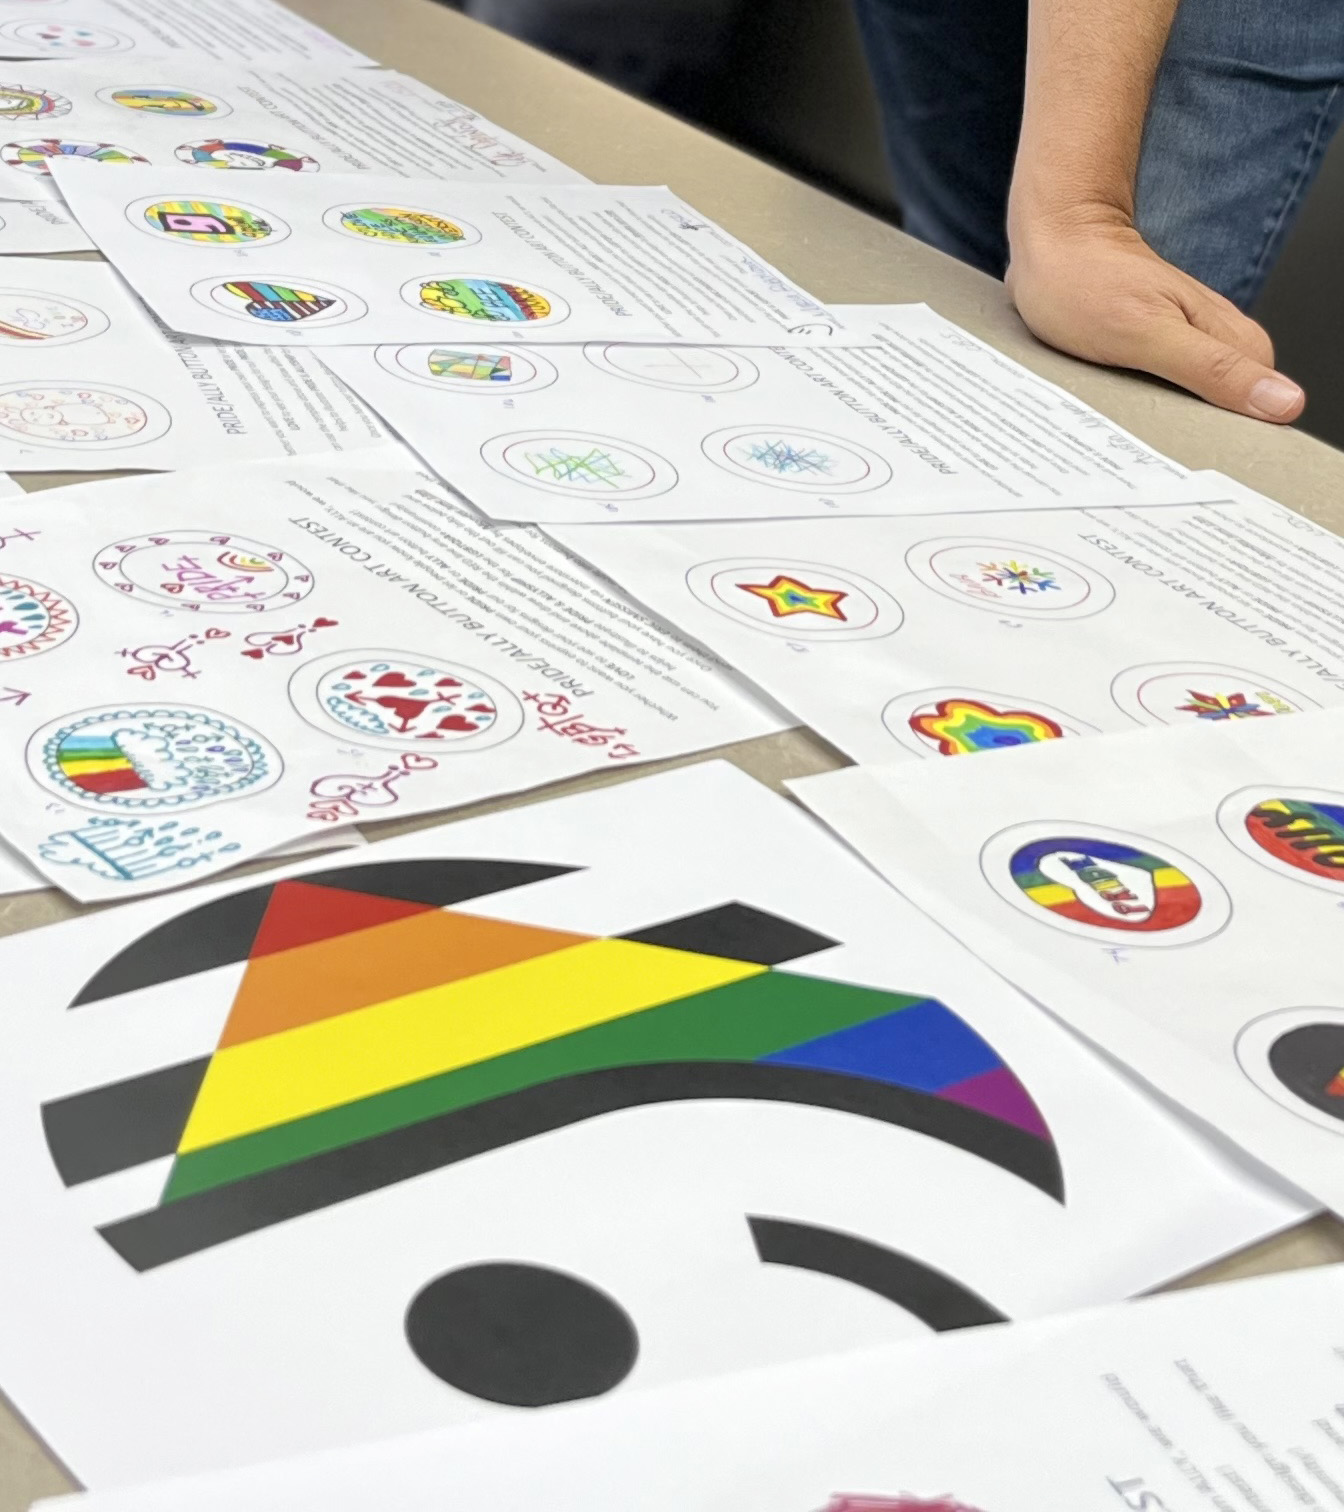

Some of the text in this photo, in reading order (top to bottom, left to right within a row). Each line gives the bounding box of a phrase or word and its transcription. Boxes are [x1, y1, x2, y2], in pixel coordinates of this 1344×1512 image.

[194, 381, 250, 433] PRIDE/ALLY
[286, 512, 598, 699] PRIDE/ALLY BUTTON ART CONTEST
[521, 689, 640, 760] LGBTQ+
[1059, 857, 1150, 914] PRIDE
